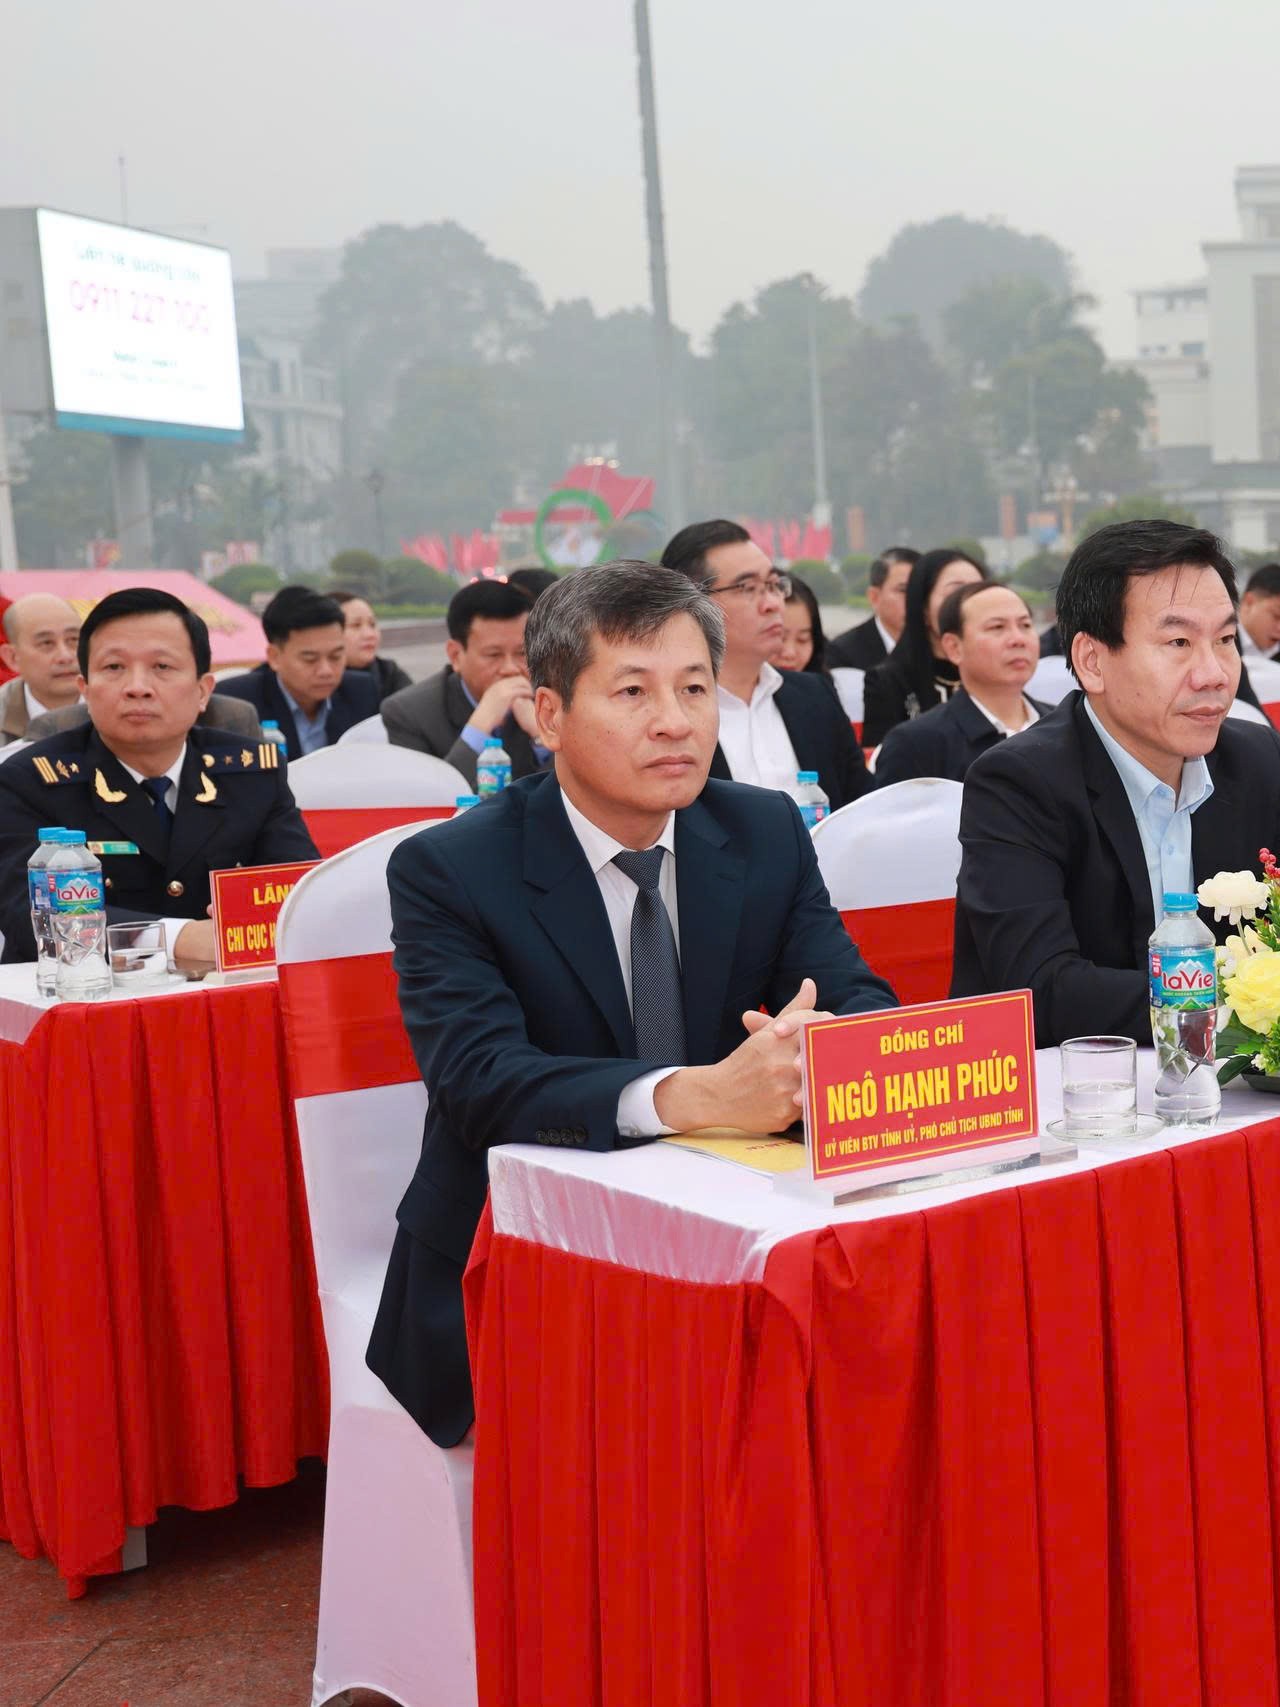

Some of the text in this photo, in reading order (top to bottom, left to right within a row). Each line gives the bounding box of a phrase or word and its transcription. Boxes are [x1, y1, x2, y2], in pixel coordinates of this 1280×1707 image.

[57, 885, 99, 900] laVie
[253, 883, 295, 905] LÃN
[227, 926, 245, 953] CHI
[246, 923, 267, 955] CỤC
[1162, 969, 1213, 989] laVie
[880, 1020, 964, 1055] ĐỒNG CHÍ
[826, 1049, 1018, 1125] NGÔ HẠNH PHÚC
[825, 1138, 837, 1158] UỶ
[839, 1135, 860, 1155] VIÊN
[862, 1136, 879, 1151] BTV
[880, 1128, 902, 1147] TỈNH
[920, 1122, 937, 1141] PHÓ
[939, 1116, 957, 1137] CHỦ
[959, 1118, 977, 1136] TỊCH
[979, 1114, 1002, 1129] UBND
[1004, 1106, 1024, 1125] TỈNH
